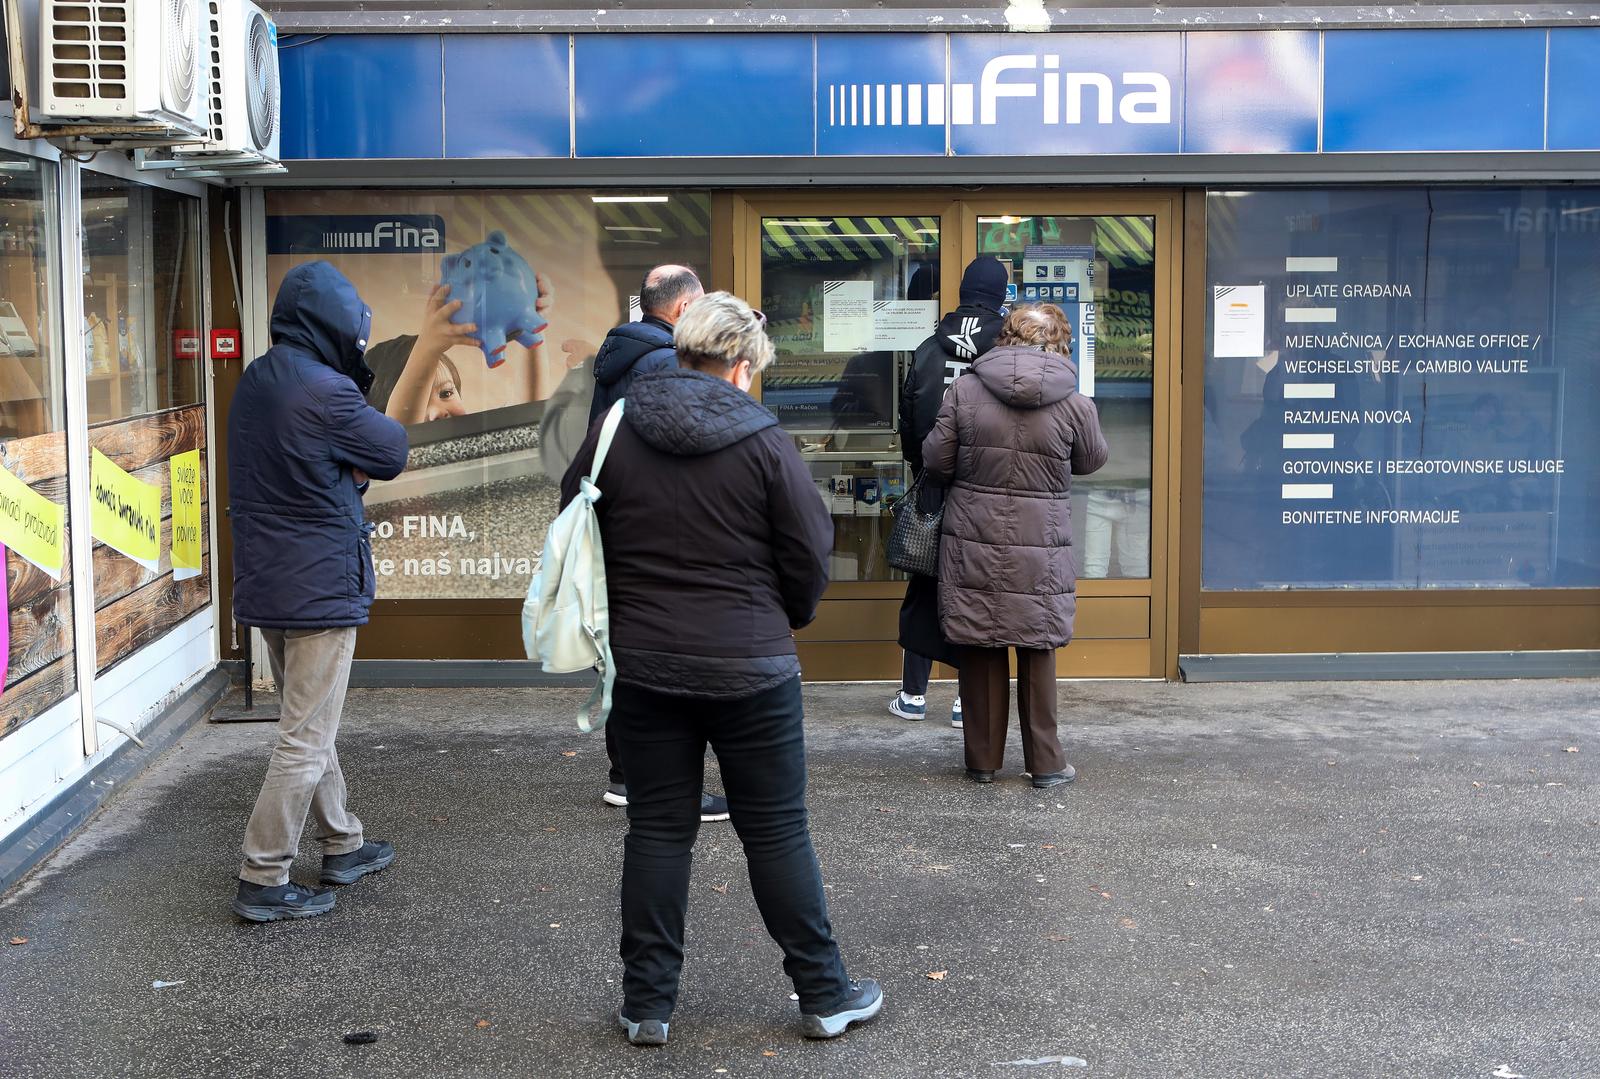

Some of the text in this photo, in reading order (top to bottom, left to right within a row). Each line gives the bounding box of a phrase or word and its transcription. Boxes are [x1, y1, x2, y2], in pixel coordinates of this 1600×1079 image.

[981, 54, 1171, 125] Fina
[374, 221, 440, 248] Fina
[1286, 284, 1412, 298] UPLATE GRAĐANA
[1082, 303, 1095, 336] Fina
[1285, 331, 1541, 351] MJENJAČNICA / EXCHANGE OFFICE /
[1284, 359, 1529, 376] WECHSELSTUBE / CAMBIO VALUTE
[1284, 410, 1412, 425] RAZMJENA NOVCA
[1282, 459, 1565, 475] GOTOVINSKE I BEZGOTOVINSKE USLUGE
[1282, 509, 1460, 525] BONITETNE INFORMACIJE
[403, 515, 476, 543] FINA,
[404, 551, 452, 576] naš
[461, 550, 543, 580] najvaž
